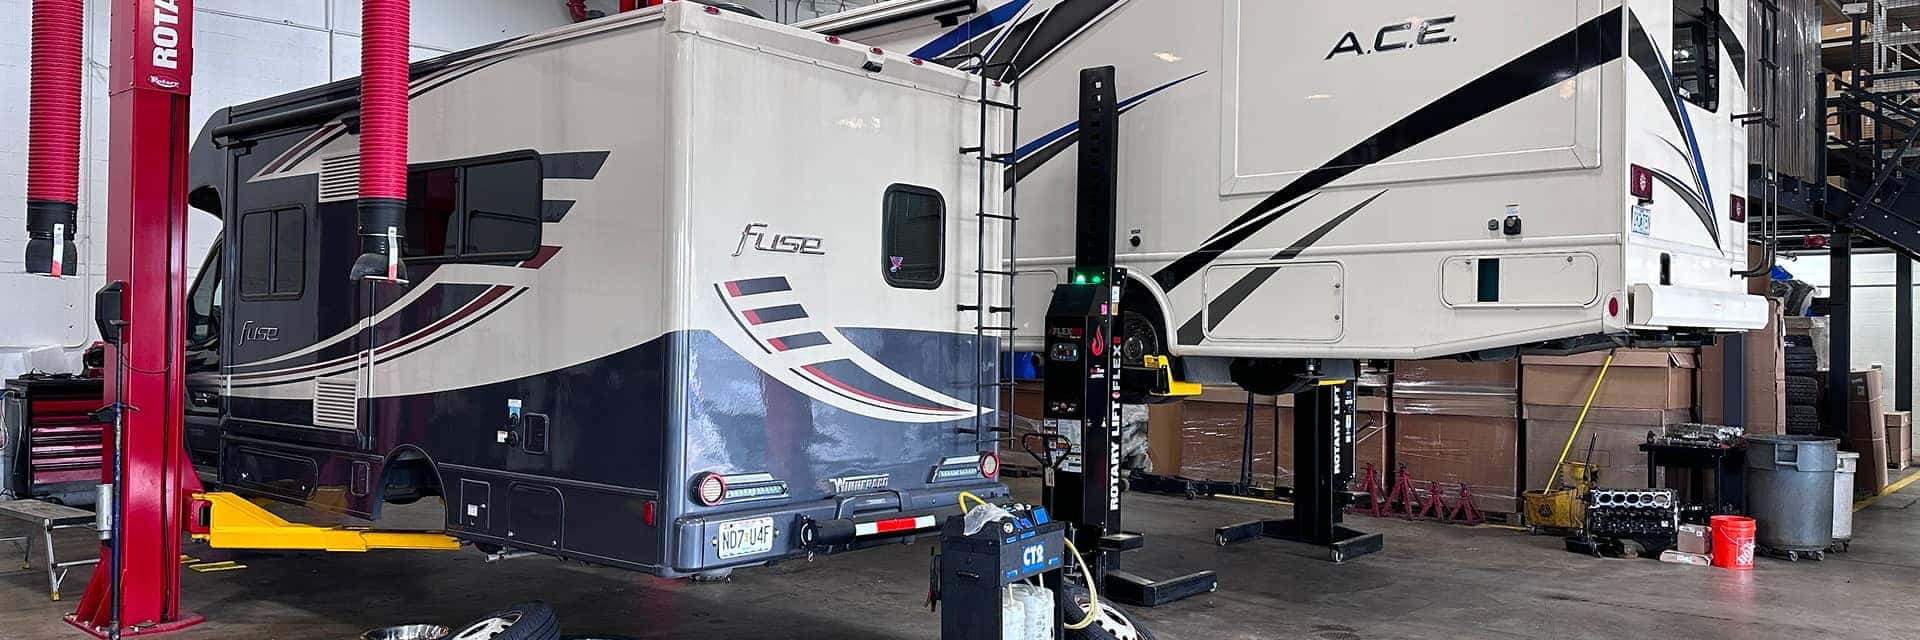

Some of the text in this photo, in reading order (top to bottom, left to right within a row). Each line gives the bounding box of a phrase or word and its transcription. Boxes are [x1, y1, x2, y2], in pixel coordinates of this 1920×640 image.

[153, 0, 179, 69] ROTA
[1324, 15, 1457, 60] A.C.E.
[1112, 344, 1120, 391] FLEX
[1111, 400, 1120, 437] LIFT
[1110, 441, 1119, 510] ROTARY
